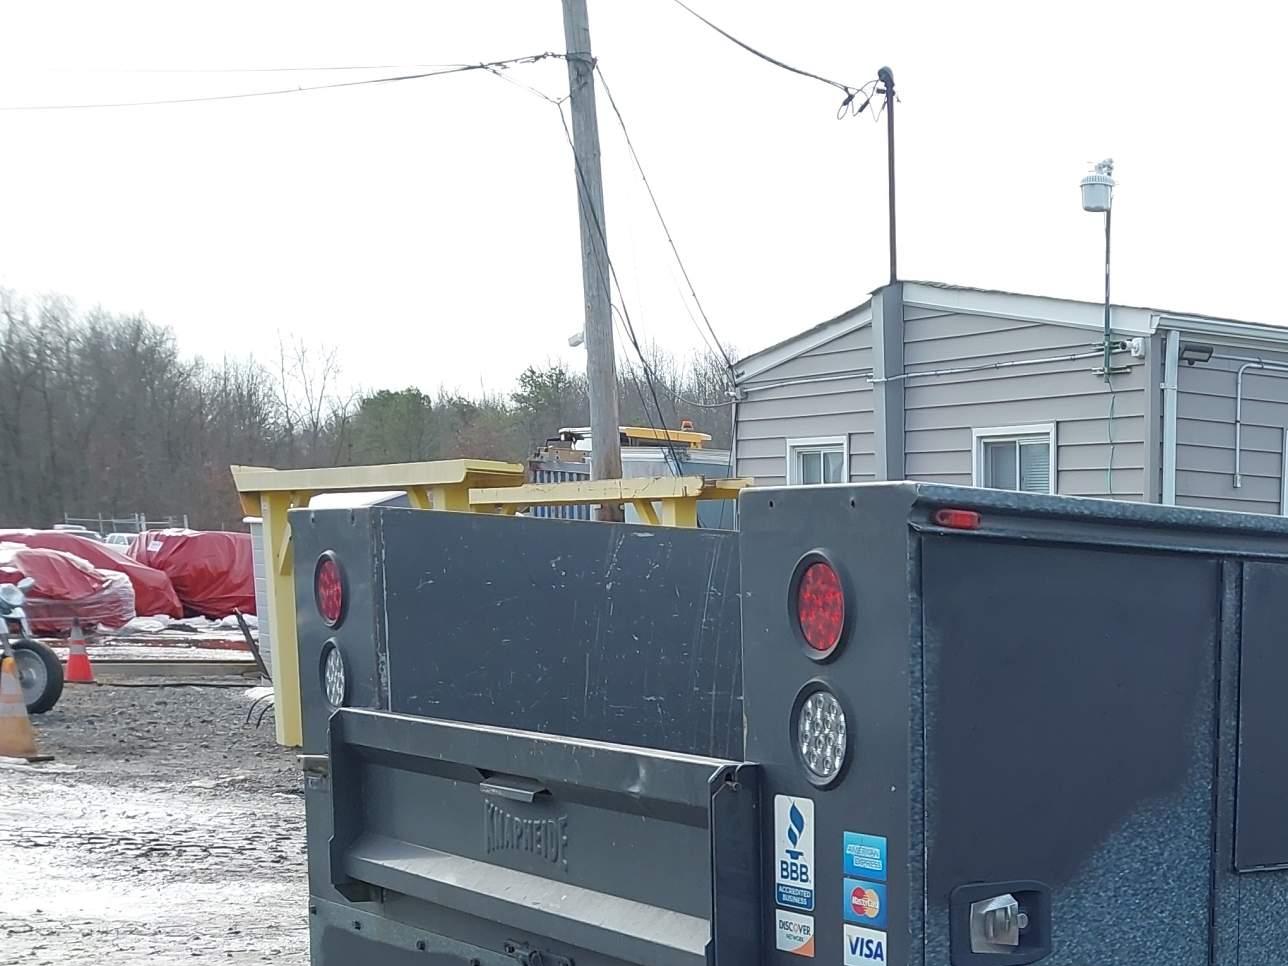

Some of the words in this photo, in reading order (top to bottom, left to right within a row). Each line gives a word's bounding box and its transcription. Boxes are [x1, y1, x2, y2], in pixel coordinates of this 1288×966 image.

[483, 799, 569, 875] KNAPHEIDE
[780, 859, 810, 883] BBB
[778, 885, 811, 898] ACCREDITED
[782, 894, 808, 905] BUSINESS
[779, 919, 811, 936] DISCOVER
[848, 934, 884, 962] VISA
